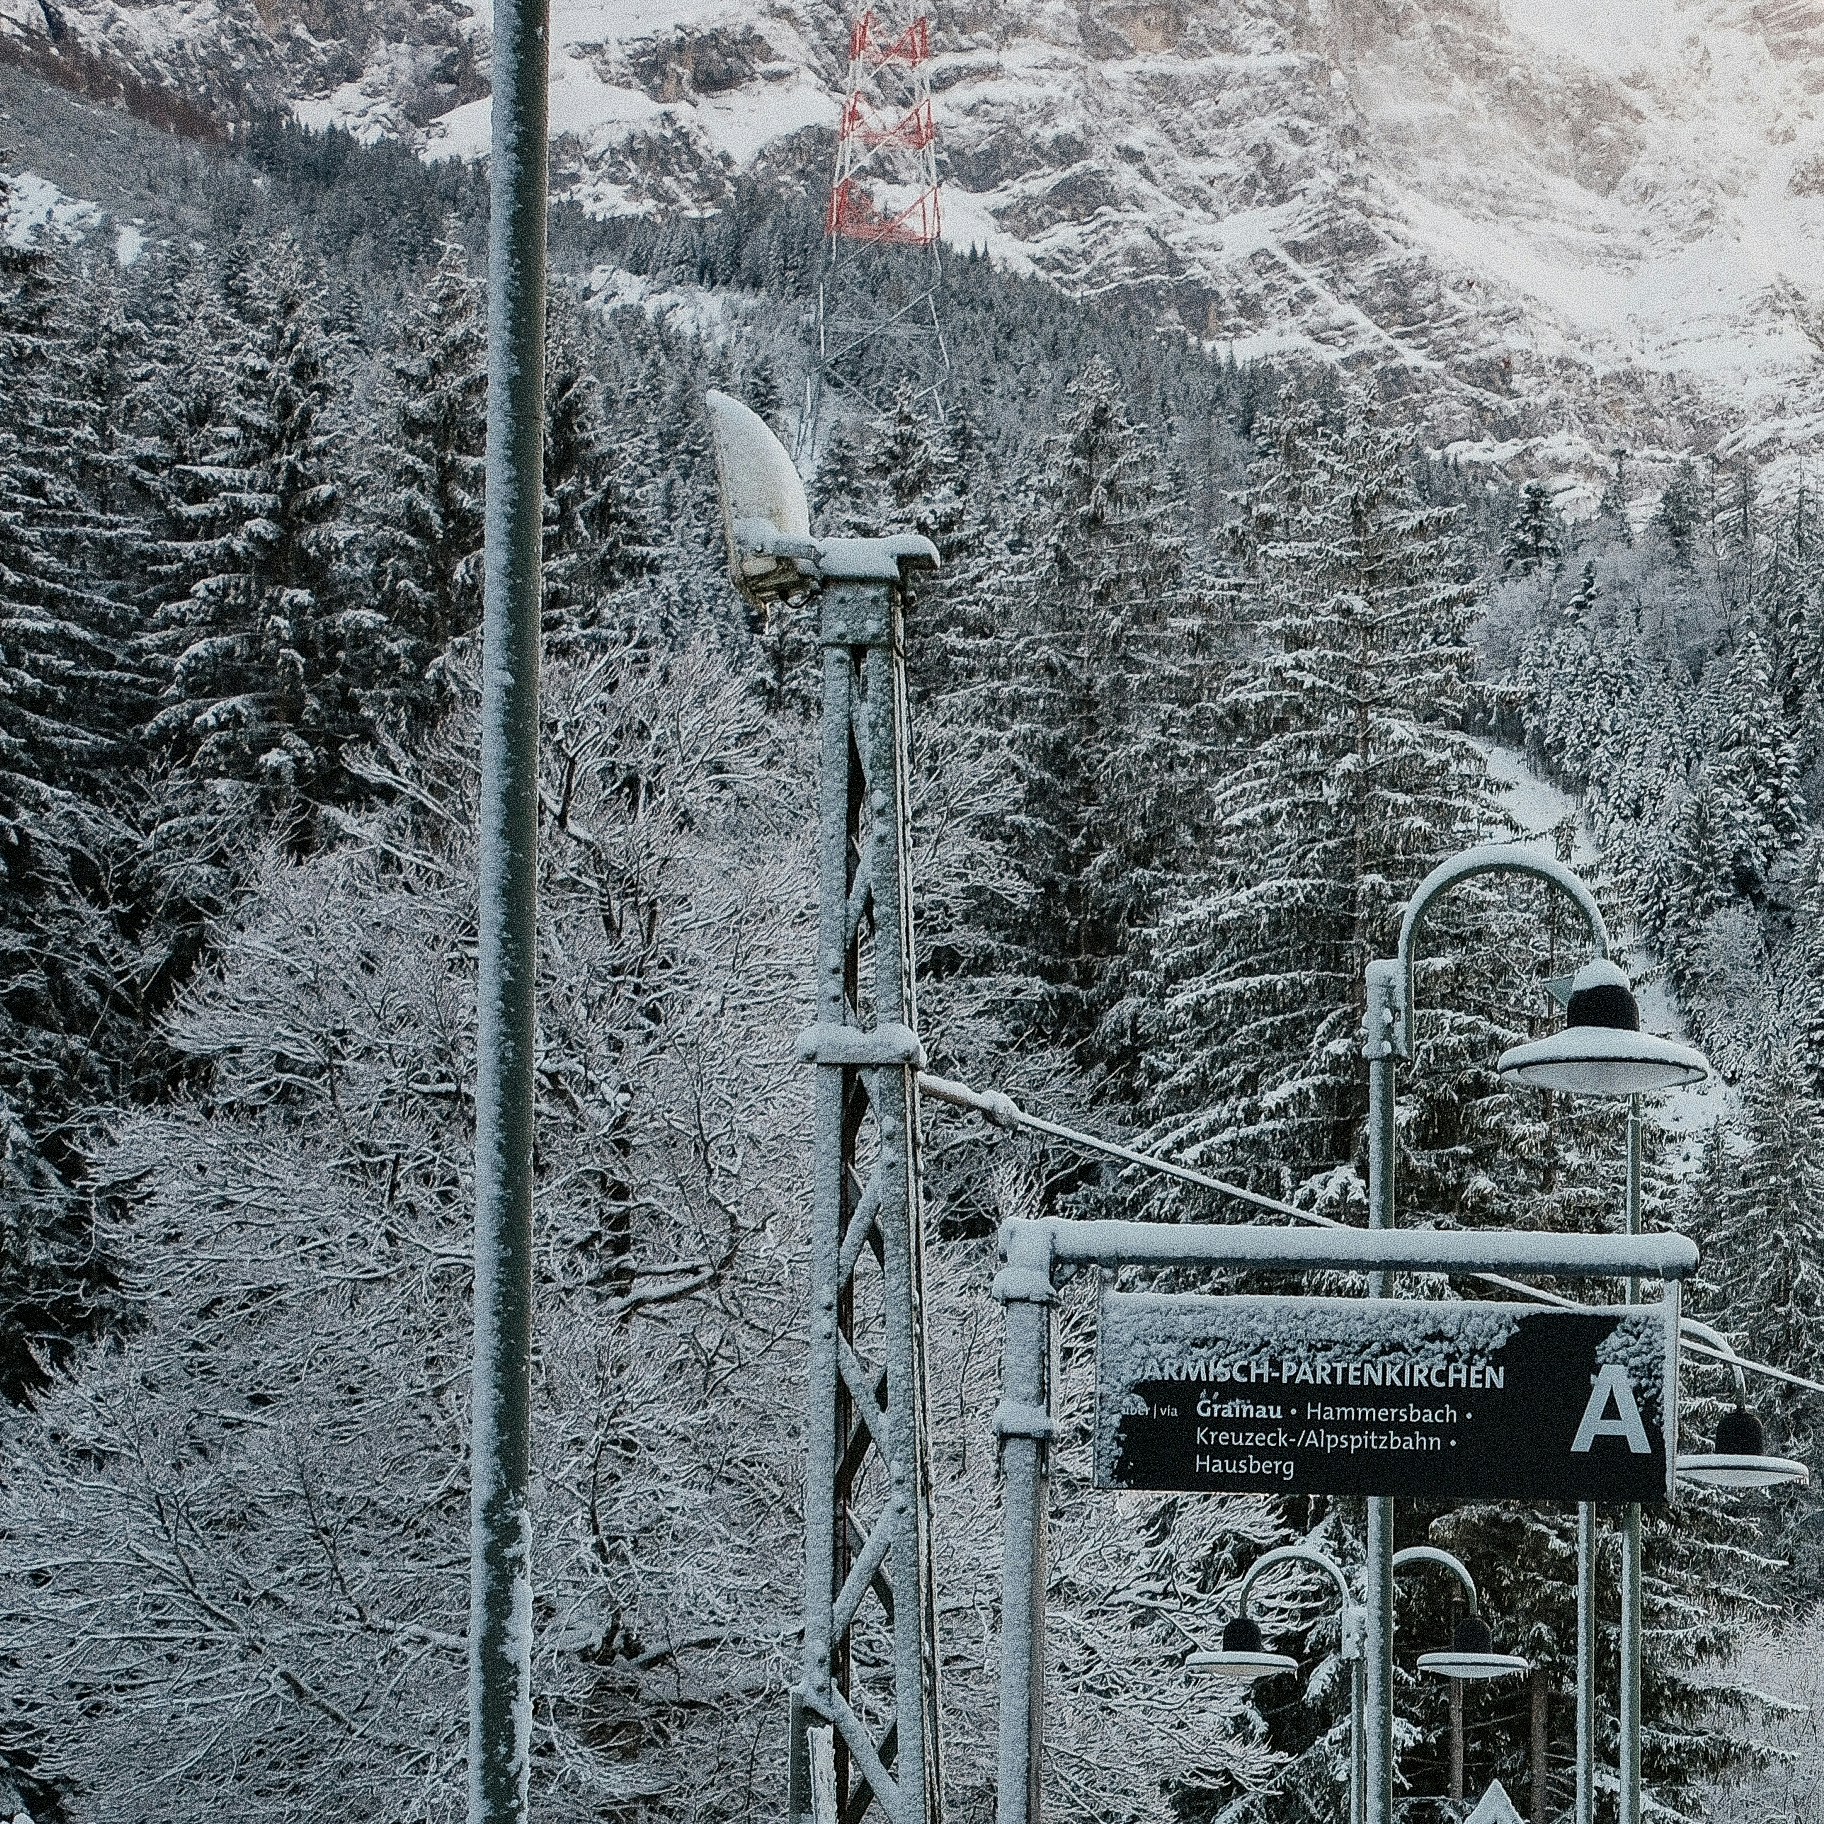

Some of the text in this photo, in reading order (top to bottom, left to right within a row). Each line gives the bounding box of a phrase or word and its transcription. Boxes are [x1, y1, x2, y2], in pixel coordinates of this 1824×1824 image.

[1132, 1358, 1504, 1389] ARMISCH-PARTENKIRCHEN
[1160, 1404, 1178, 1417] via
[1196, 1400, 1457, 1423] Grainau Hammersbach
[1570, 1364, 1651, 1454] A
[1196, 1427, 1441, 1454] Kreuzeck-/Alpspitzbahn
[1195, 1454, 1295, 1480] Hausberg
